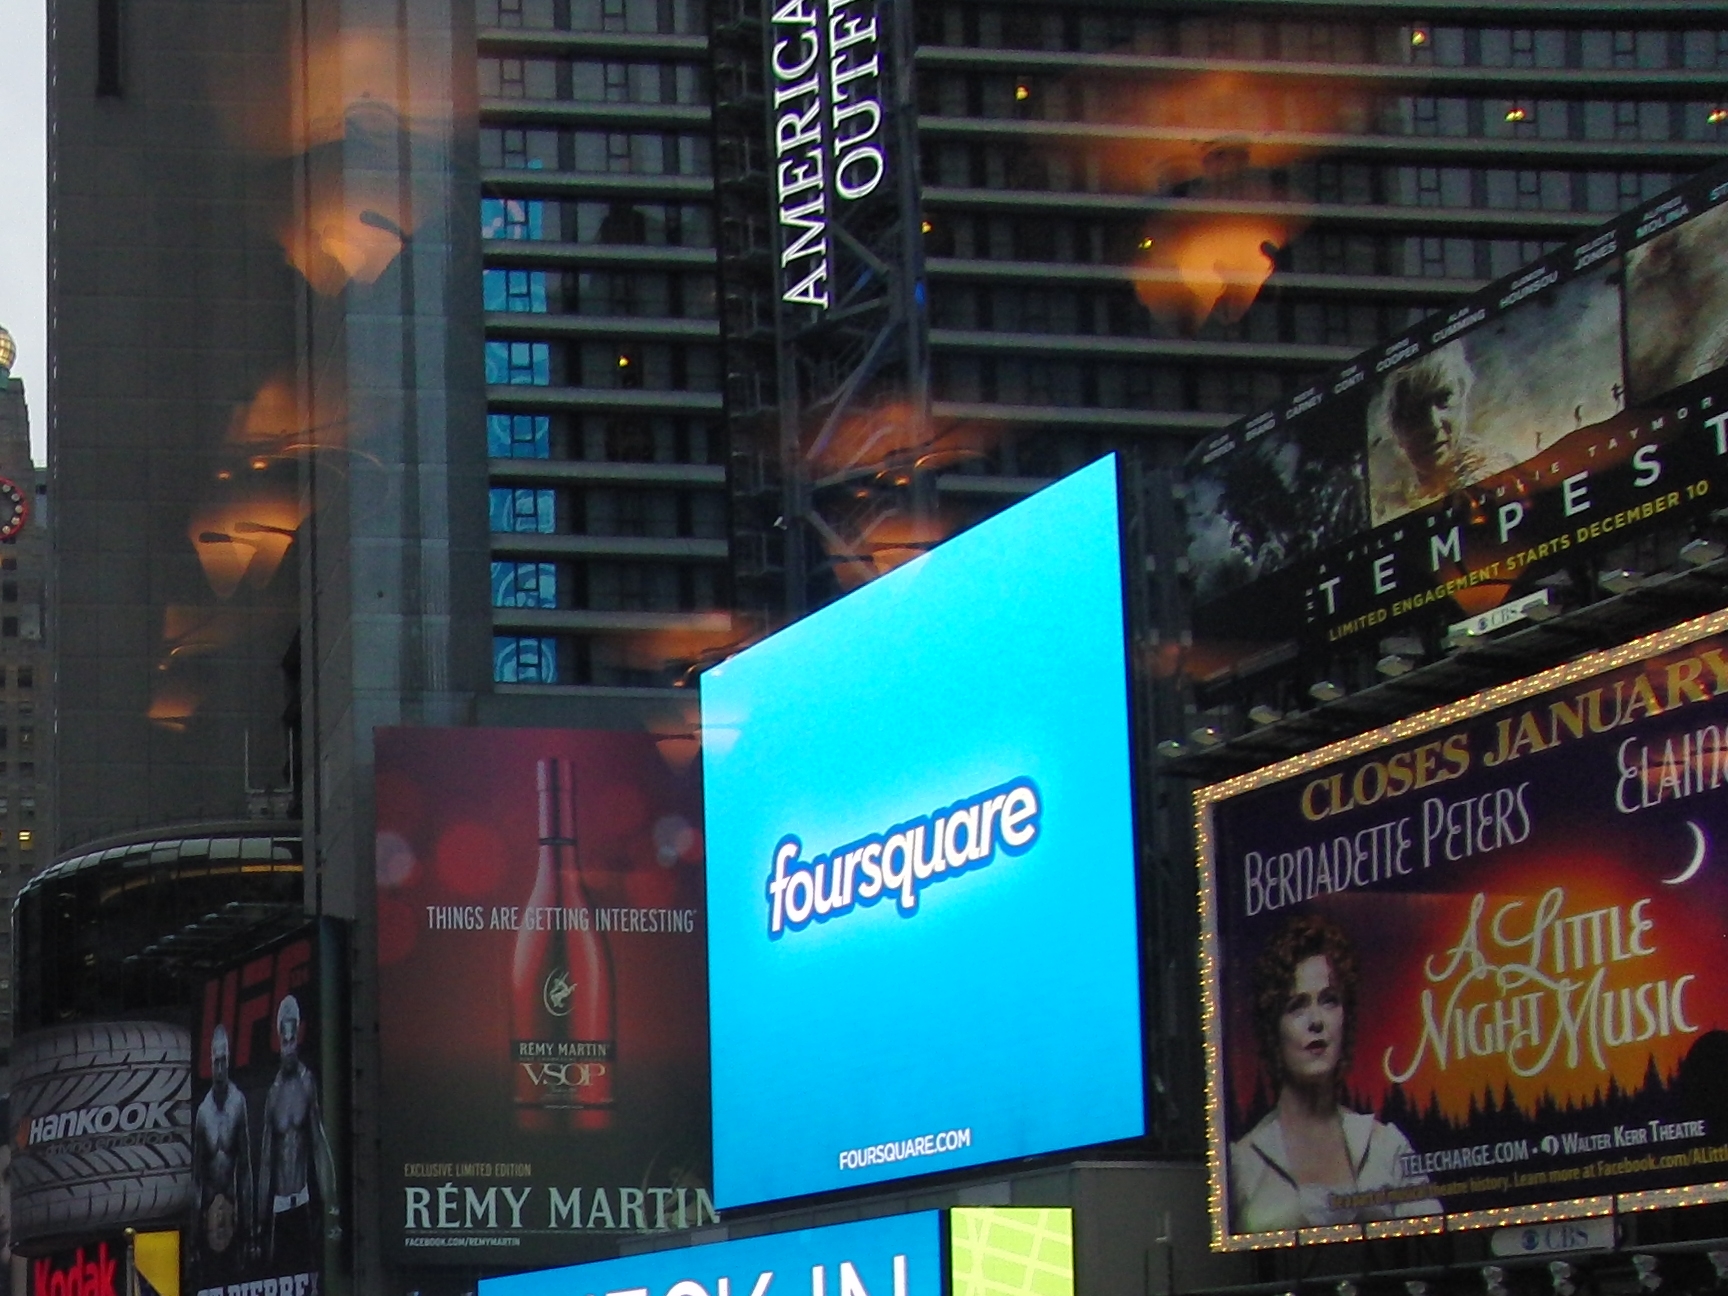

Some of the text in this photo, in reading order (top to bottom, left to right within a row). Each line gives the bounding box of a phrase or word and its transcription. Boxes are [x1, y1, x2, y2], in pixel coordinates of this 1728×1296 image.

[1427, 508, 1455, 527] BY
[1587, 396, 1714, 458] TAYMOR
[1318, 410, 1728, 617] TEMPEST
[1328, 479, 1710, 642] LIMITED ENGAGEMENT STARTS DECEMBER 10
[1300, 736, 1472, 822] CLOSES
[769, 787, 1039, 933] foursquare
[1243, 782, 1531, 918] BERNADETTE PETERS
[426, 906, 694, 933] THINGS ARE GETTING INTERESTING
[519, 1042, 607, 1056] RÉMY MARTIN
[95, 1131, 173, 1150] emotion
[838, 1128, 972, 1171] FOURSQUARE.COM
[1401, 1139, 1529, 1176] TELECHARGE.COM
[404, 1163, 531, 1177] EXCLUSIVE LIMITED EDITION
[1514, 1170, 1547, 1189] Learn
[1549, 1168, 1579, 1186] more
[1582, 1167, 1595, 1181] at
[404, 1182, 532, 1228] RÉMY
